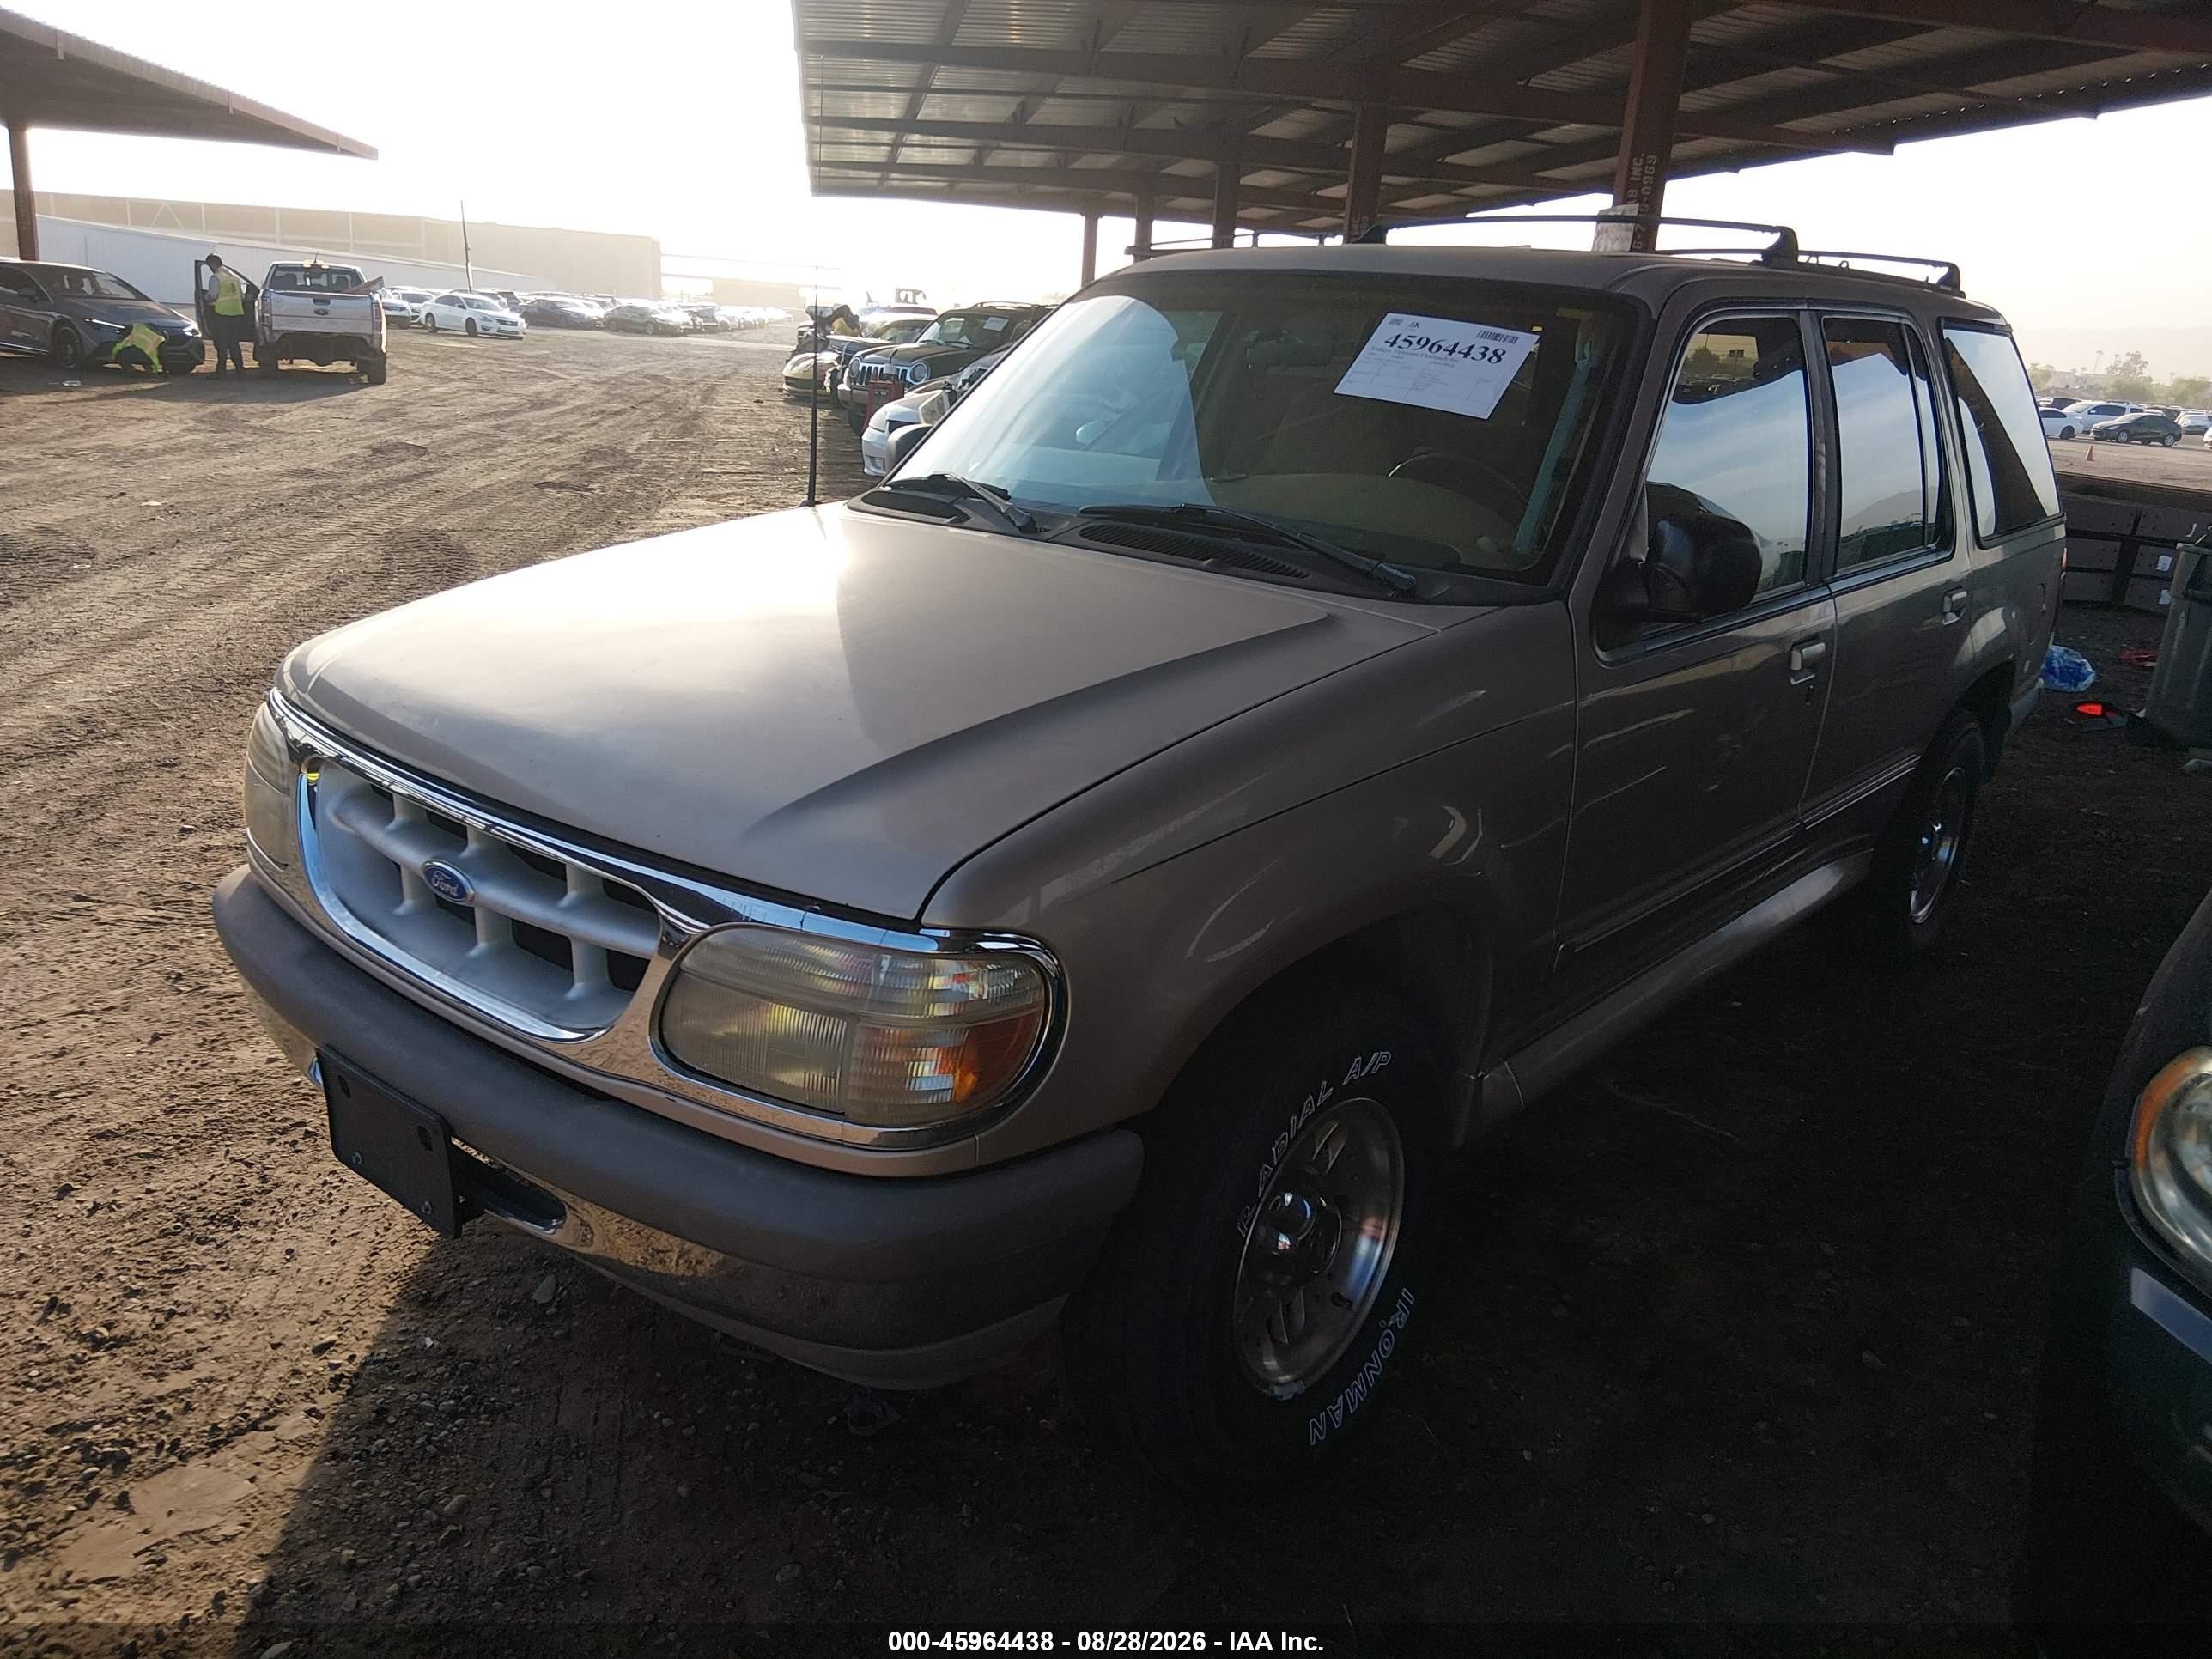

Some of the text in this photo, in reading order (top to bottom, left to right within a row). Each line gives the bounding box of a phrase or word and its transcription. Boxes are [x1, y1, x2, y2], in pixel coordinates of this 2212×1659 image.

[1384, 332, 1507, 364] 45964438
[431, 870, 459, 896] Ford
[1237, 1079, 1334, 1237] RADIAL
[1309, 1287, 1416, 1446] IRONMAN
